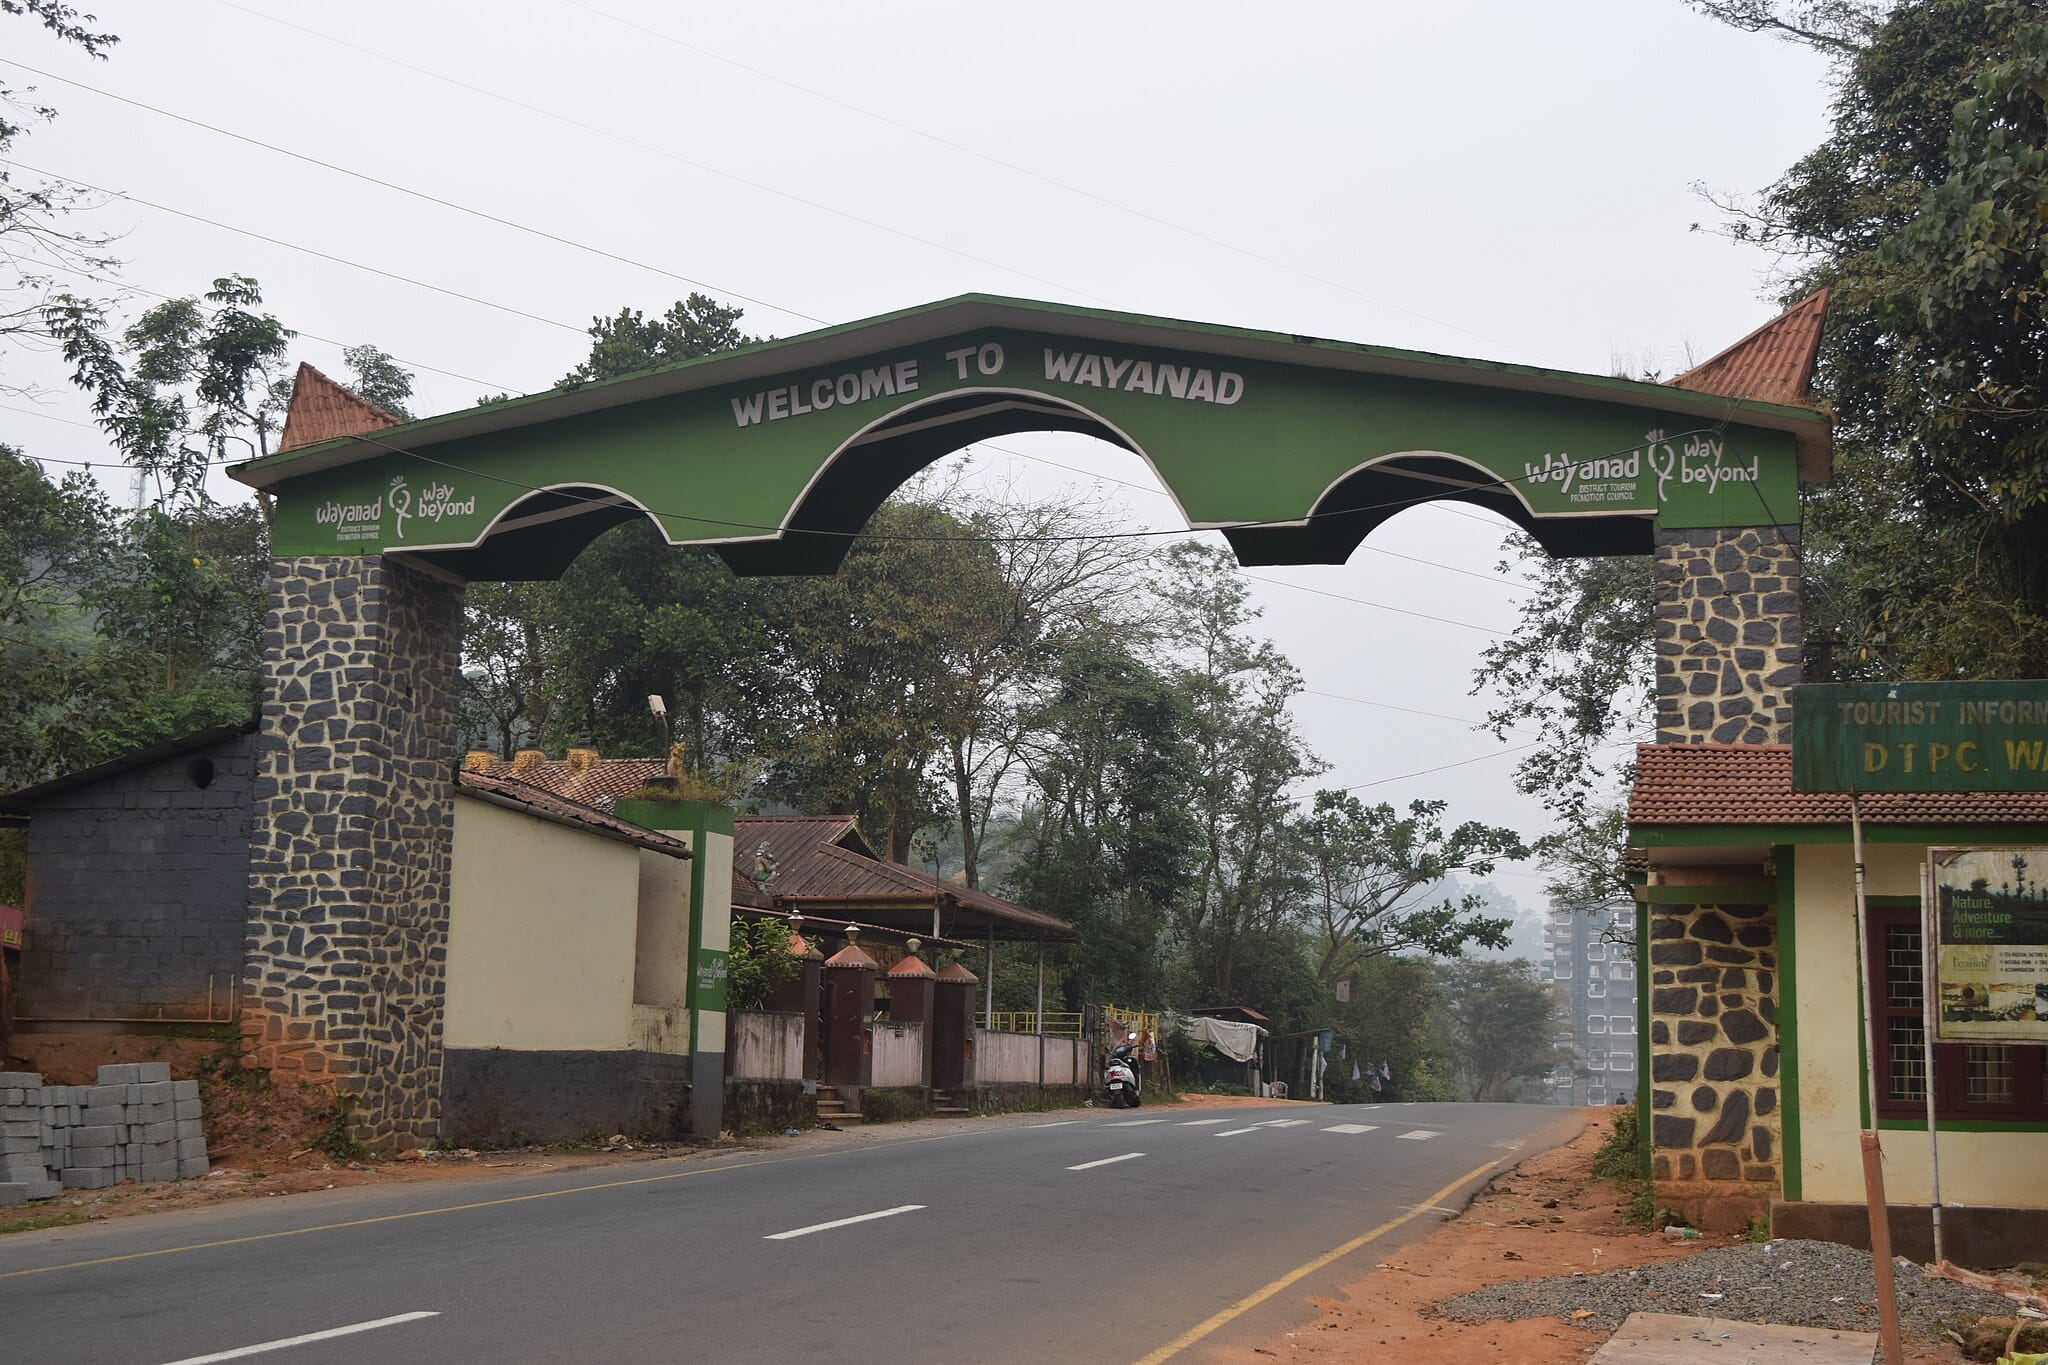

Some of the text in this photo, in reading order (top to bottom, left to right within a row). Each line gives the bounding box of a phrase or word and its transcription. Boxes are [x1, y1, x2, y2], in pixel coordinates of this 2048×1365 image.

[731, 342, 1245, 427] WELCOME TO WAYANAD
[1684, 435, 1724, 466] way
[1681, 455, 1759, 494] beyond
[423, 481, 455, 502] way
[418, 496, 475, 523] beyond
[1838, 701, 1941, 725] TOURIST
[1953, 912, 2012, 923] Adventure
